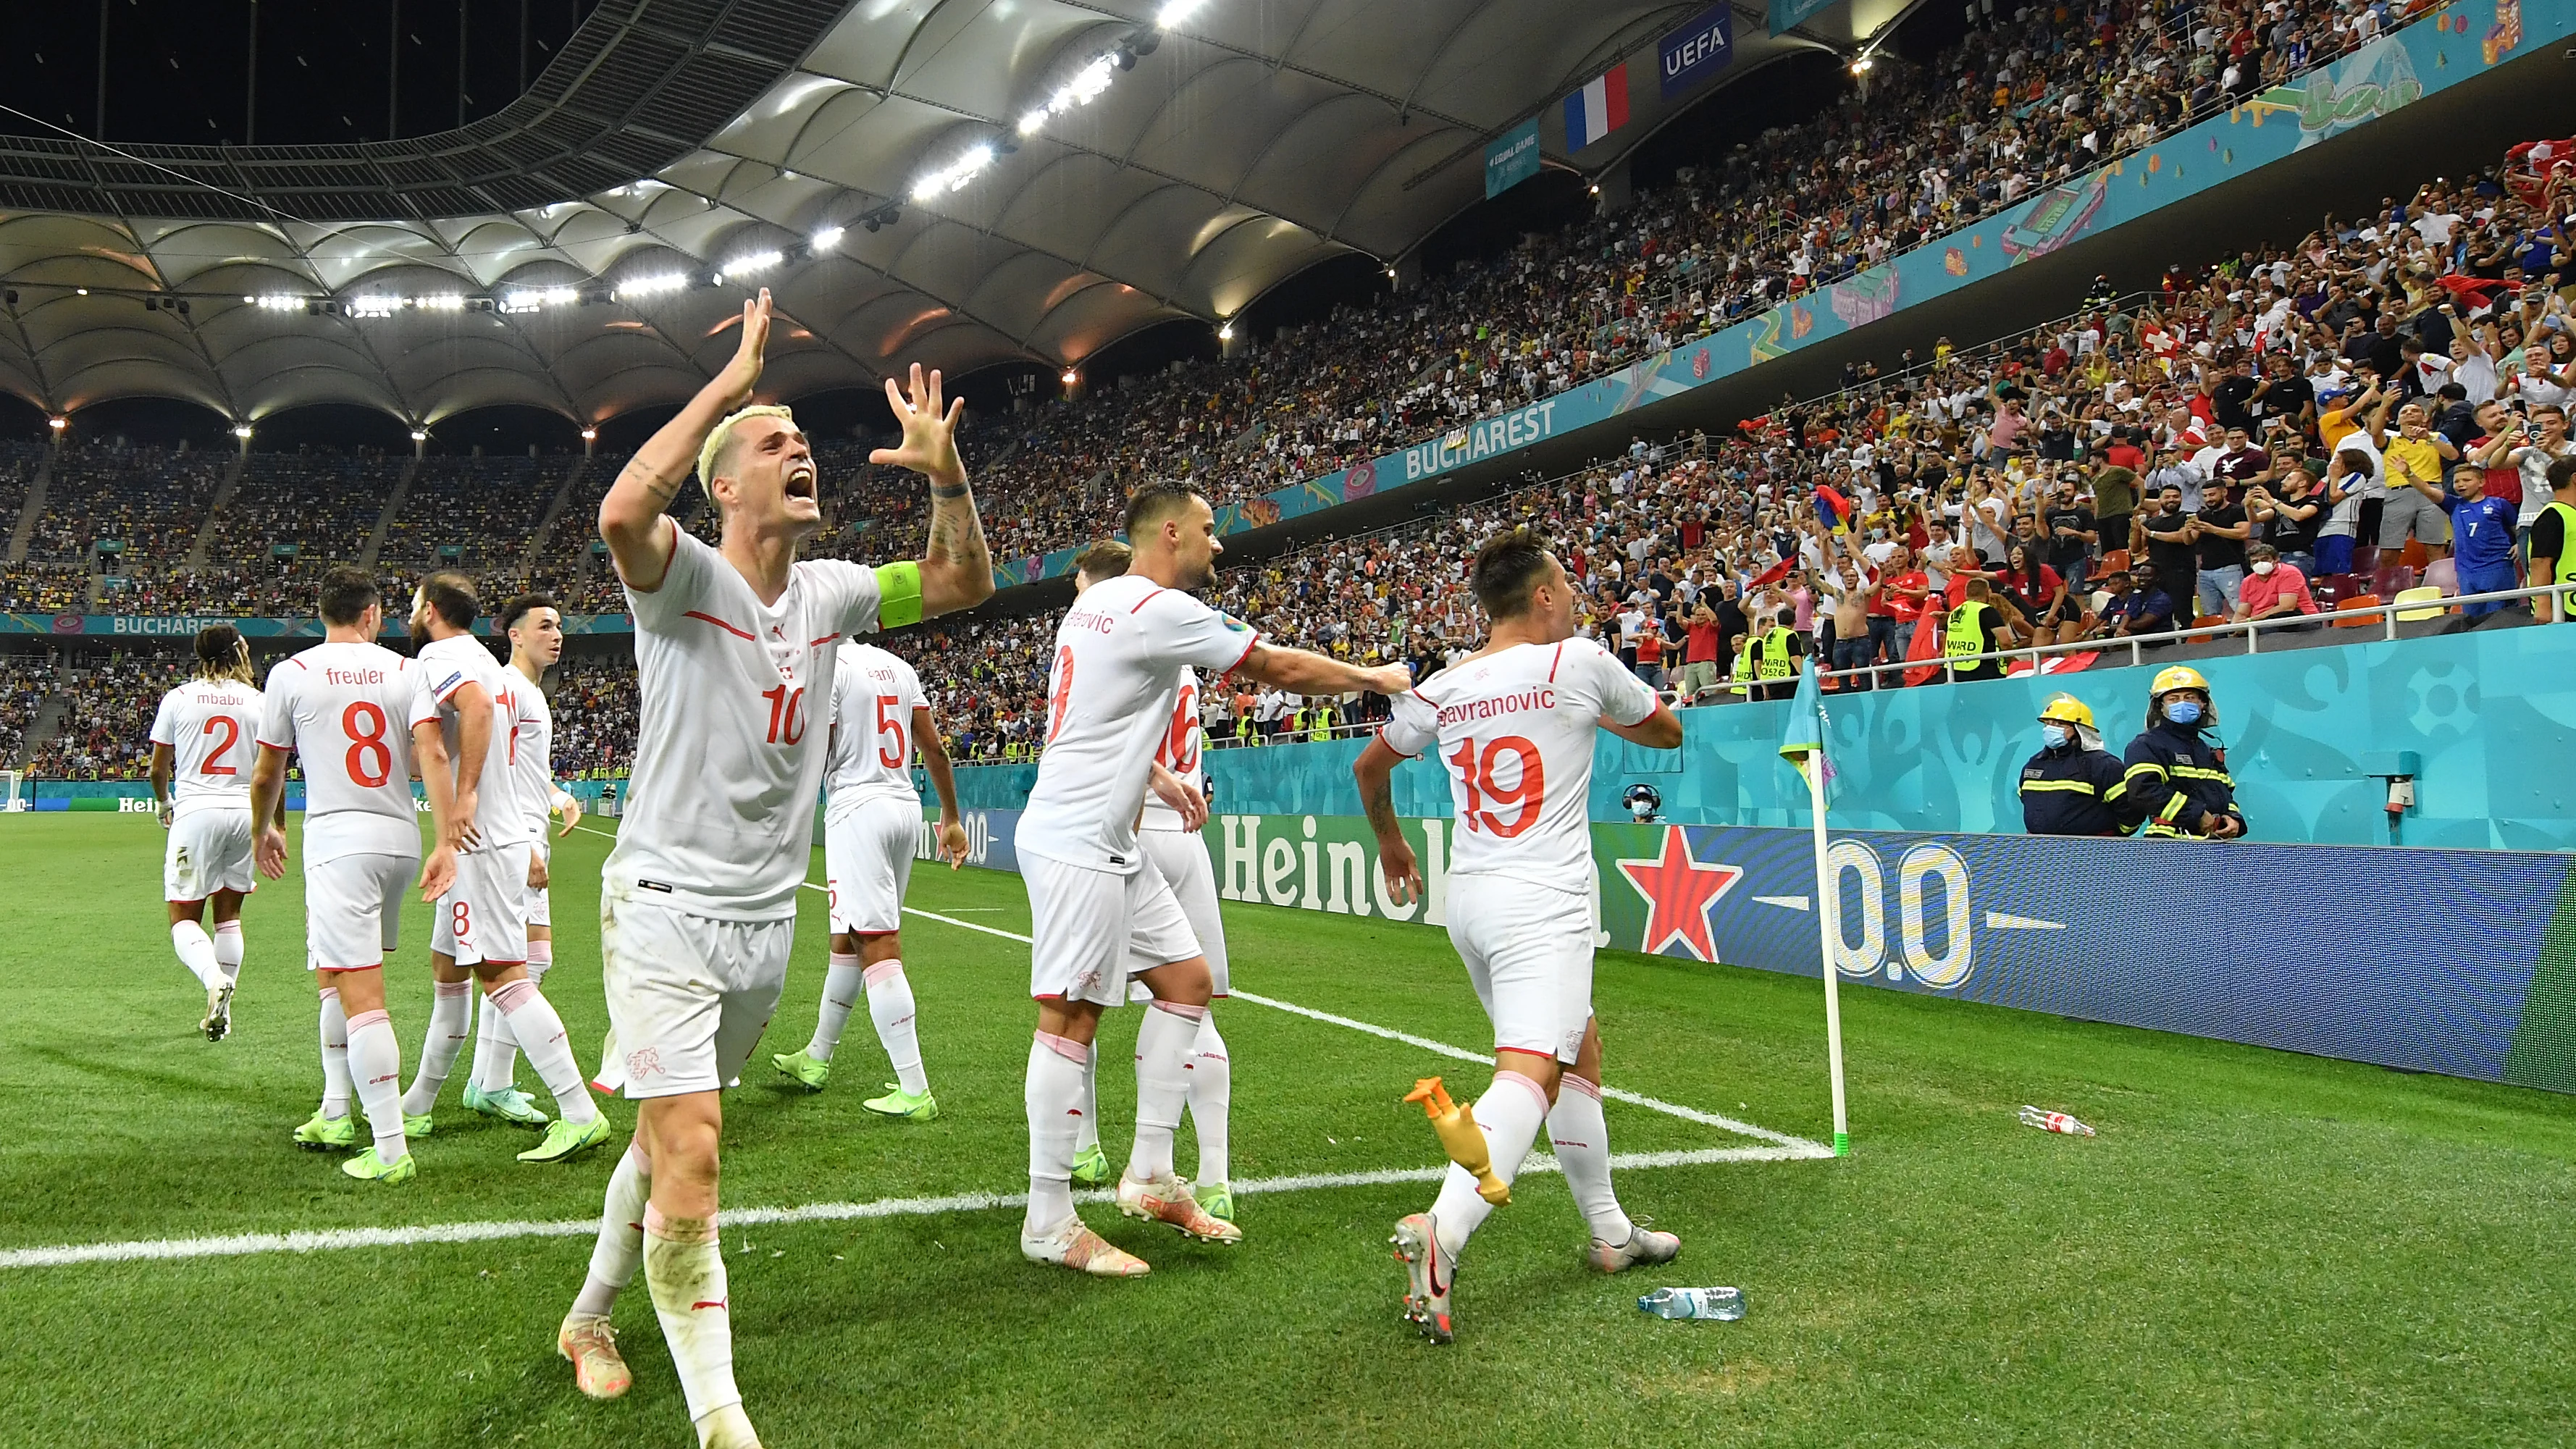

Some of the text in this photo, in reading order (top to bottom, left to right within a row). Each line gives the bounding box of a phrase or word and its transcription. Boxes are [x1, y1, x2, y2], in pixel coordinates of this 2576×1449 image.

[1666, 27, 1725, 75] UEFA
[1406, 400, 1556, 479] BUCHAREST
[2468, 522, 2478, 537] 7
[197, 693, 243, 705] mbabu
[326, 668, 385, 685] freuler
[201, 715, 239, 775] 2
[342, 701, 391, 788] 8
[762, 684, 806, 746] 10
[877, 694, 905, 769] 5
[1449, 735, 1545, 839] 19
[453, 901, 470, 936] 8
[1827, 838, 1976, 989] 0.0
